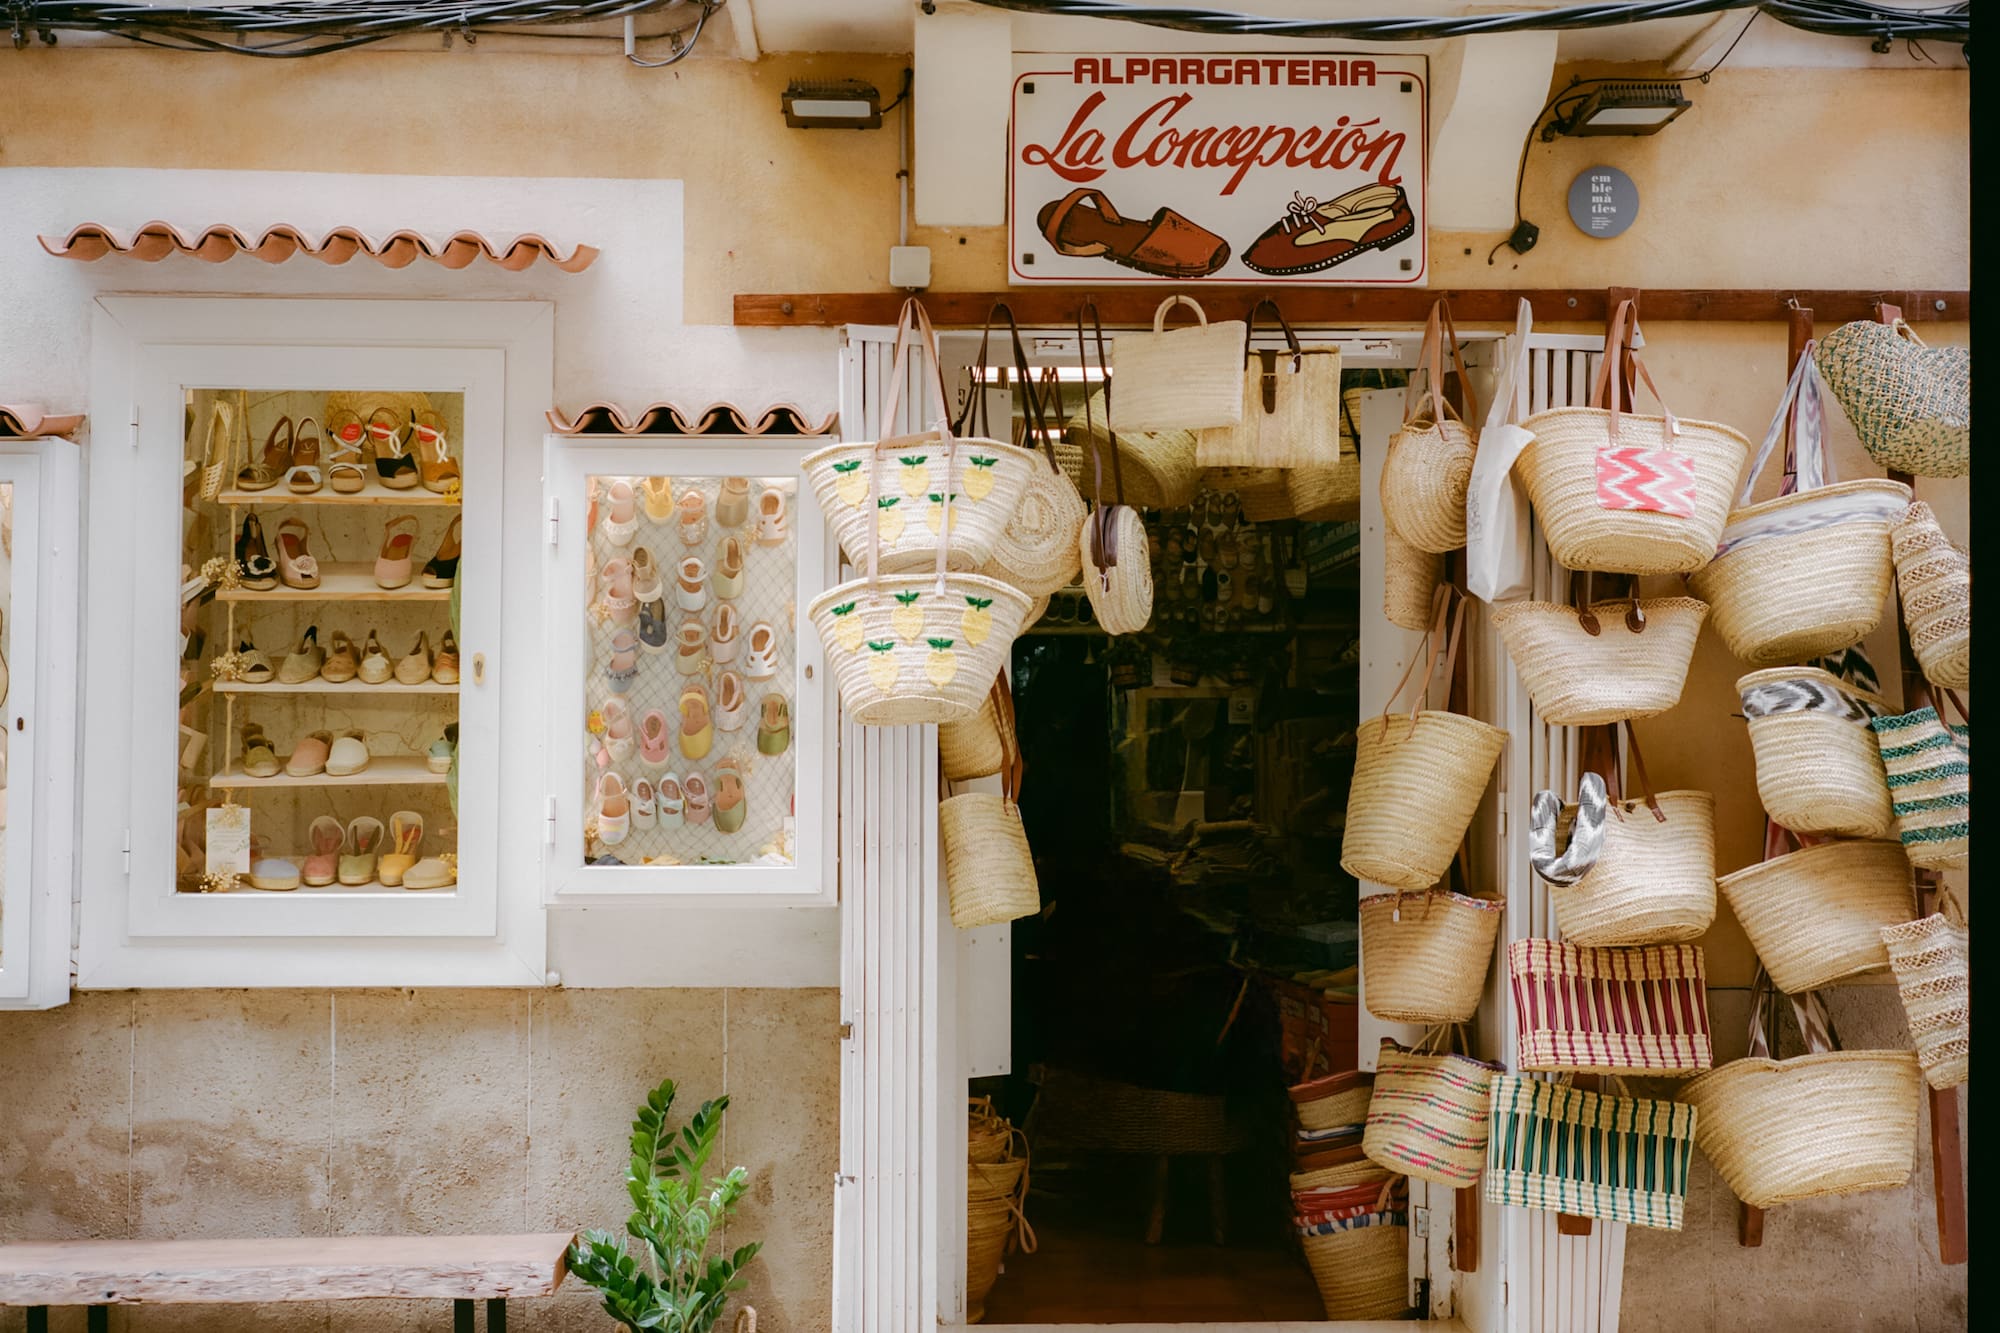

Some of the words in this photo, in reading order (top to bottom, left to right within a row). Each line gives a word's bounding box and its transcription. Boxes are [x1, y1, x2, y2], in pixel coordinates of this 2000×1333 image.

[1073, 58, 1376, 86] ALPARGATERIA
[1021, 90, 1108, 183] La
[1111, 92, 1407, 196] Concepción
[1591, 175, 1611, 183] em
[1591, 183, 1613, 193] ble
